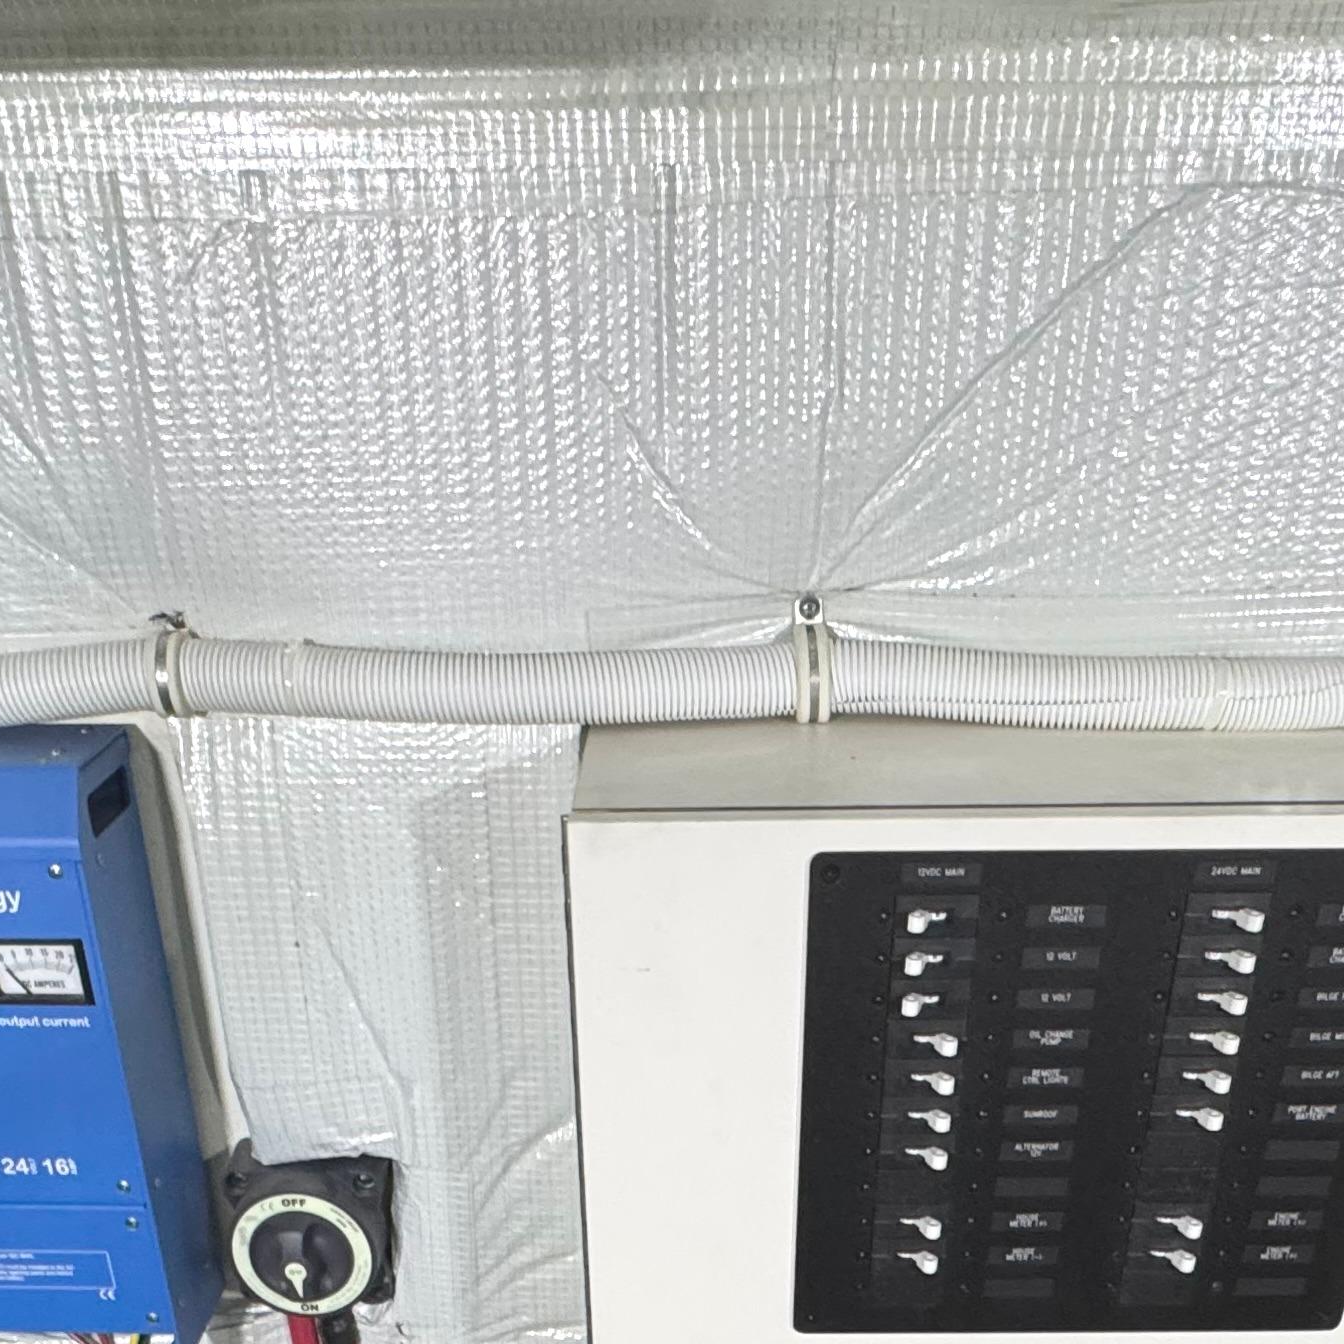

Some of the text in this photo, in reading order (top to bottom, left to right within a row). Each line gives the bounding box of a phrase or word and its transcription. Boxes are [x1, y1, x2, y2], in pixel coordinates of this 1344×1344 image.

[945, 867, 965, 877] MAIN
[1211, 866, 1263, 876] 24VDC MAIN
[42, 1016, 91, 1028] current
[281, 1198, 306, 1208] OFF
[301, 1303, 319, 1312] ON
